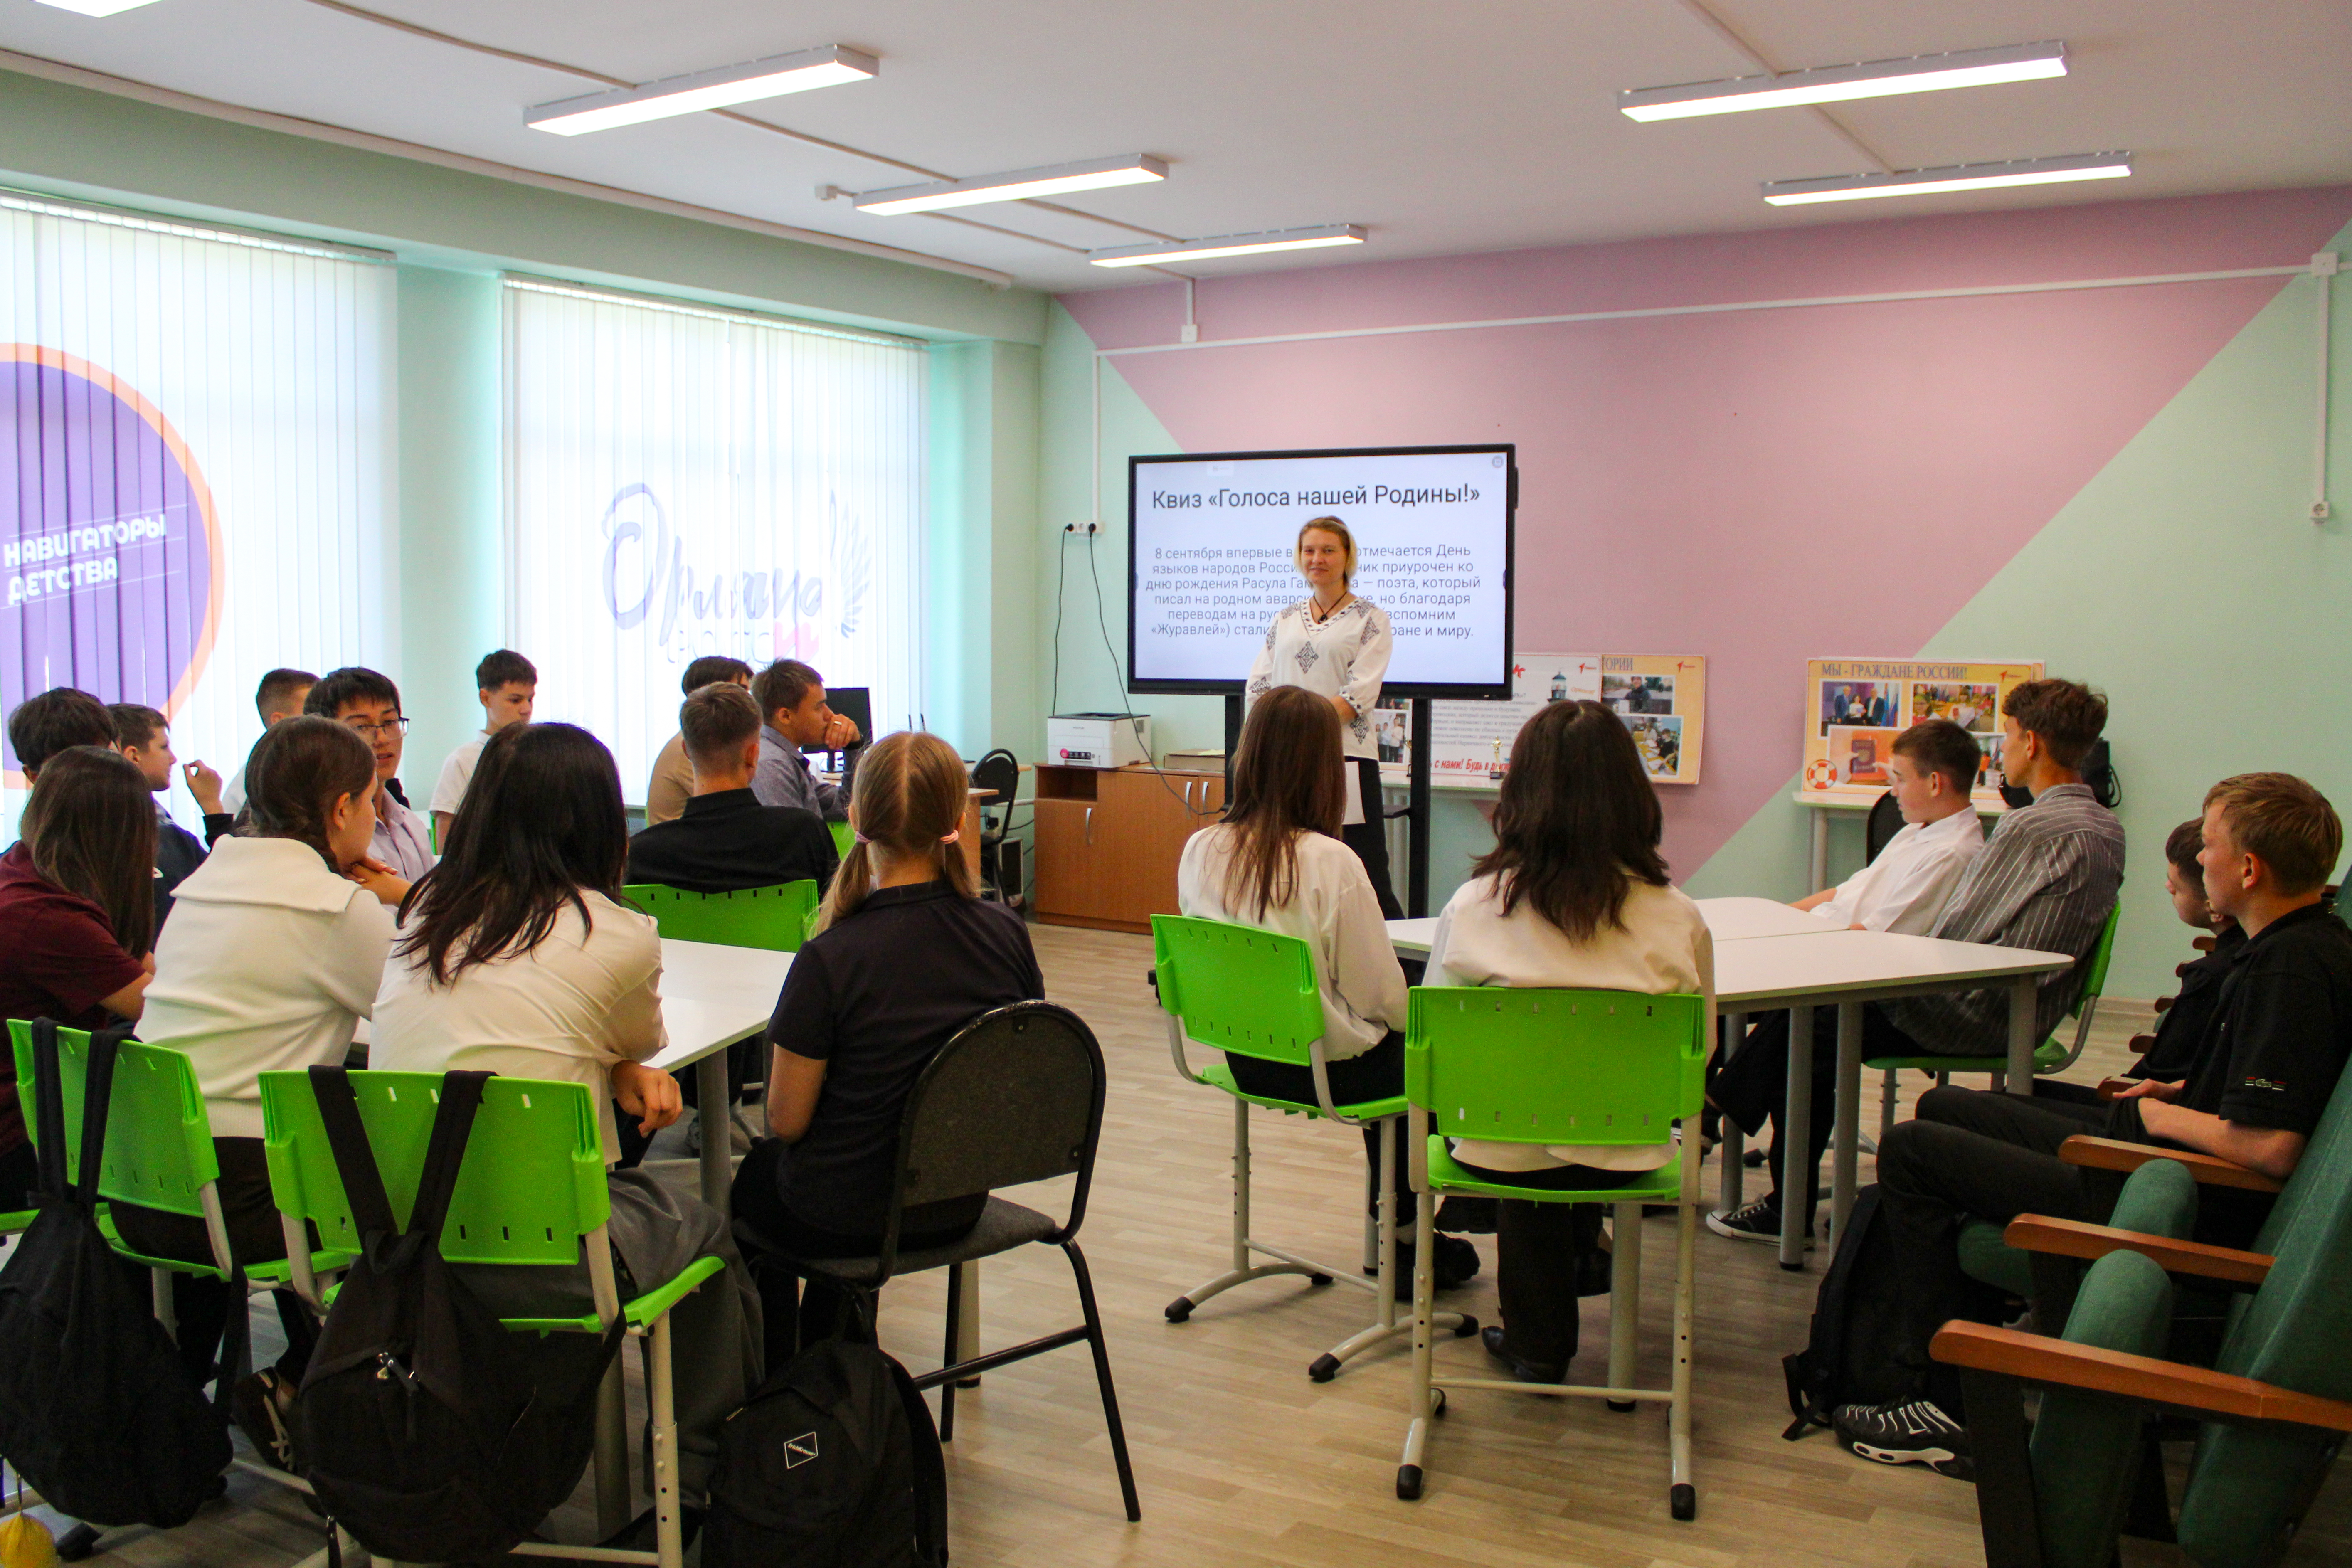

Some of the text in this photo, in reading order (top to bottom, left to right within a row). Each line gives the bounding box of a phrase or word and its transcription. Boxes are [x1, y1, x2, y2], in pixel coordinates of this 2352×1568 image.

[1153, 483, 1481, 509] Квиз «Голоса нашей Родины!»
[4, 514, 167, 567] НАВИГАТОРЫ
[1155, 547, 1162, 559] 8
[1166, 547, 1222, 561] сентября
[1226, 548, 1282, 560] впервые
[1286, 549, 1293, 557] в
[1436, 544, 1471, 558] День
[1153, 565, 1198, 574] языков
[1203, 564, 1255, 577] народов
[1260, 562, 1298, 573] Росси
[1383, 562, 1453, 575] приурочен
[1458, 562, 1474, 572] ко
[7, 556, 118, 605] ДЕТСТВА
[1146, 581, 1172, 591] дню
[1175, 580, 1238, 592] рождения
[1242, 577, 1286, 591] Расула
[1378, 579, 1418, 590] поэта,
[1423, 576, 1481, 590] который
[1155, 595, 1191, 604] писал
[1196, 595, 1209, 604] на
[1213, 594, 1261, 607] родном
[1380, 594, 1396, 604] но
[1400, 592, 1471, 607] благодаря
[1168, 610, 1237, 622] переводам
[1241, 610, 1255, 619] на
[1152, 624, 1230, 638] «Журавлей»)
[1425, 627, 1432, 636] и
[1437, 626, 1474, 639] миру.
[1822, 664, 1842, 676] МЫ
[1851, 664, 1913, 678] ГРАЖДАНЕ
[1916, 665, 1967, 679] РОССИИ!
[1435, 759, 1440, 768] с
[1441, 759, 1464, 769] нами!
[1466, 759, 1483, 772] Будь
